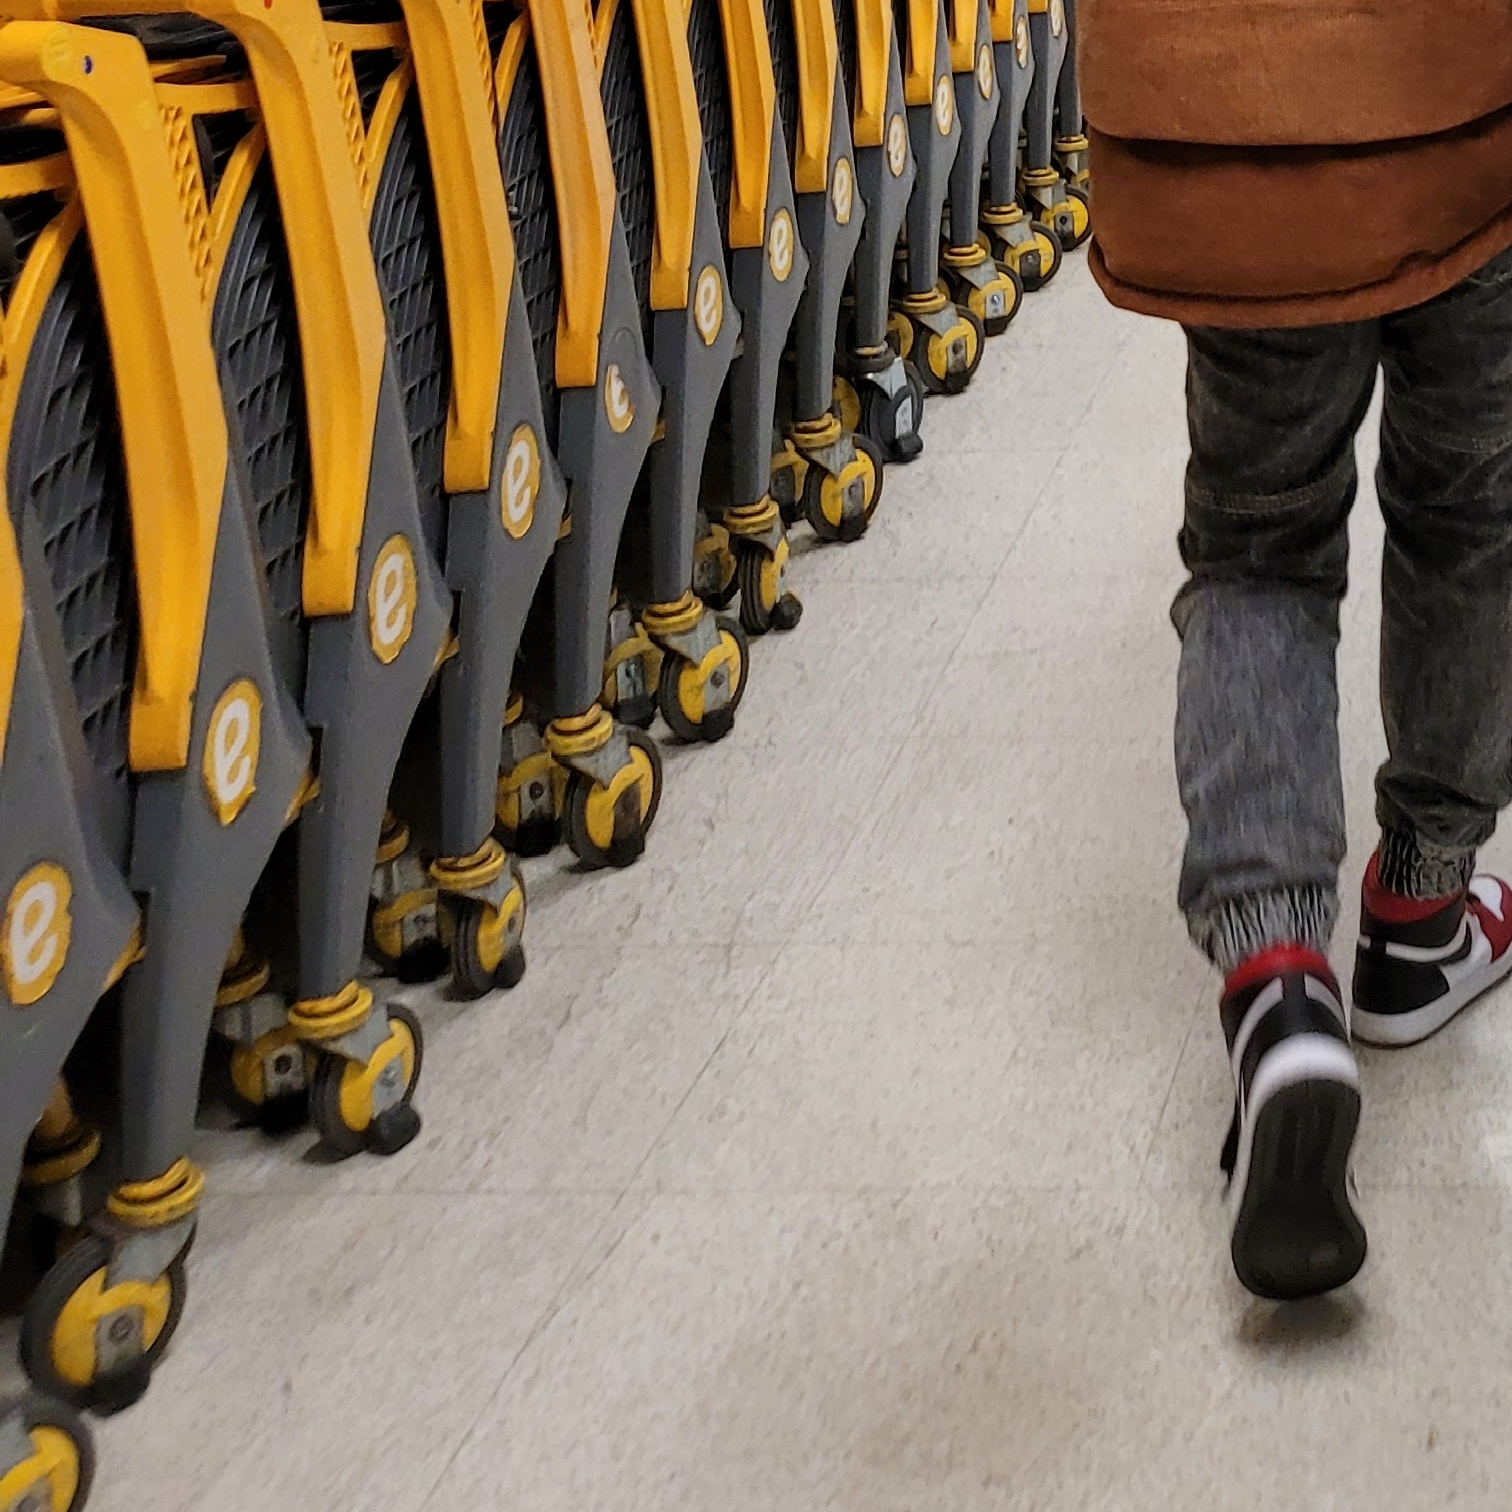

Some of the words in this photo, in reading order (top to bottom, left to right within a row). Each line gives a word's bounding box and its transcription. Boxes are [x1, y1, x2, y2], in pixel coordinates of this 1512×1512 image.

[773, 219, 788, 270] e
[698, 277, 716, 333] e
[505, 441, 529, 522] e
[377, 555, 405, 644] e
[214, 700, 250, 802] e
[11, 883, 56, 983] e
